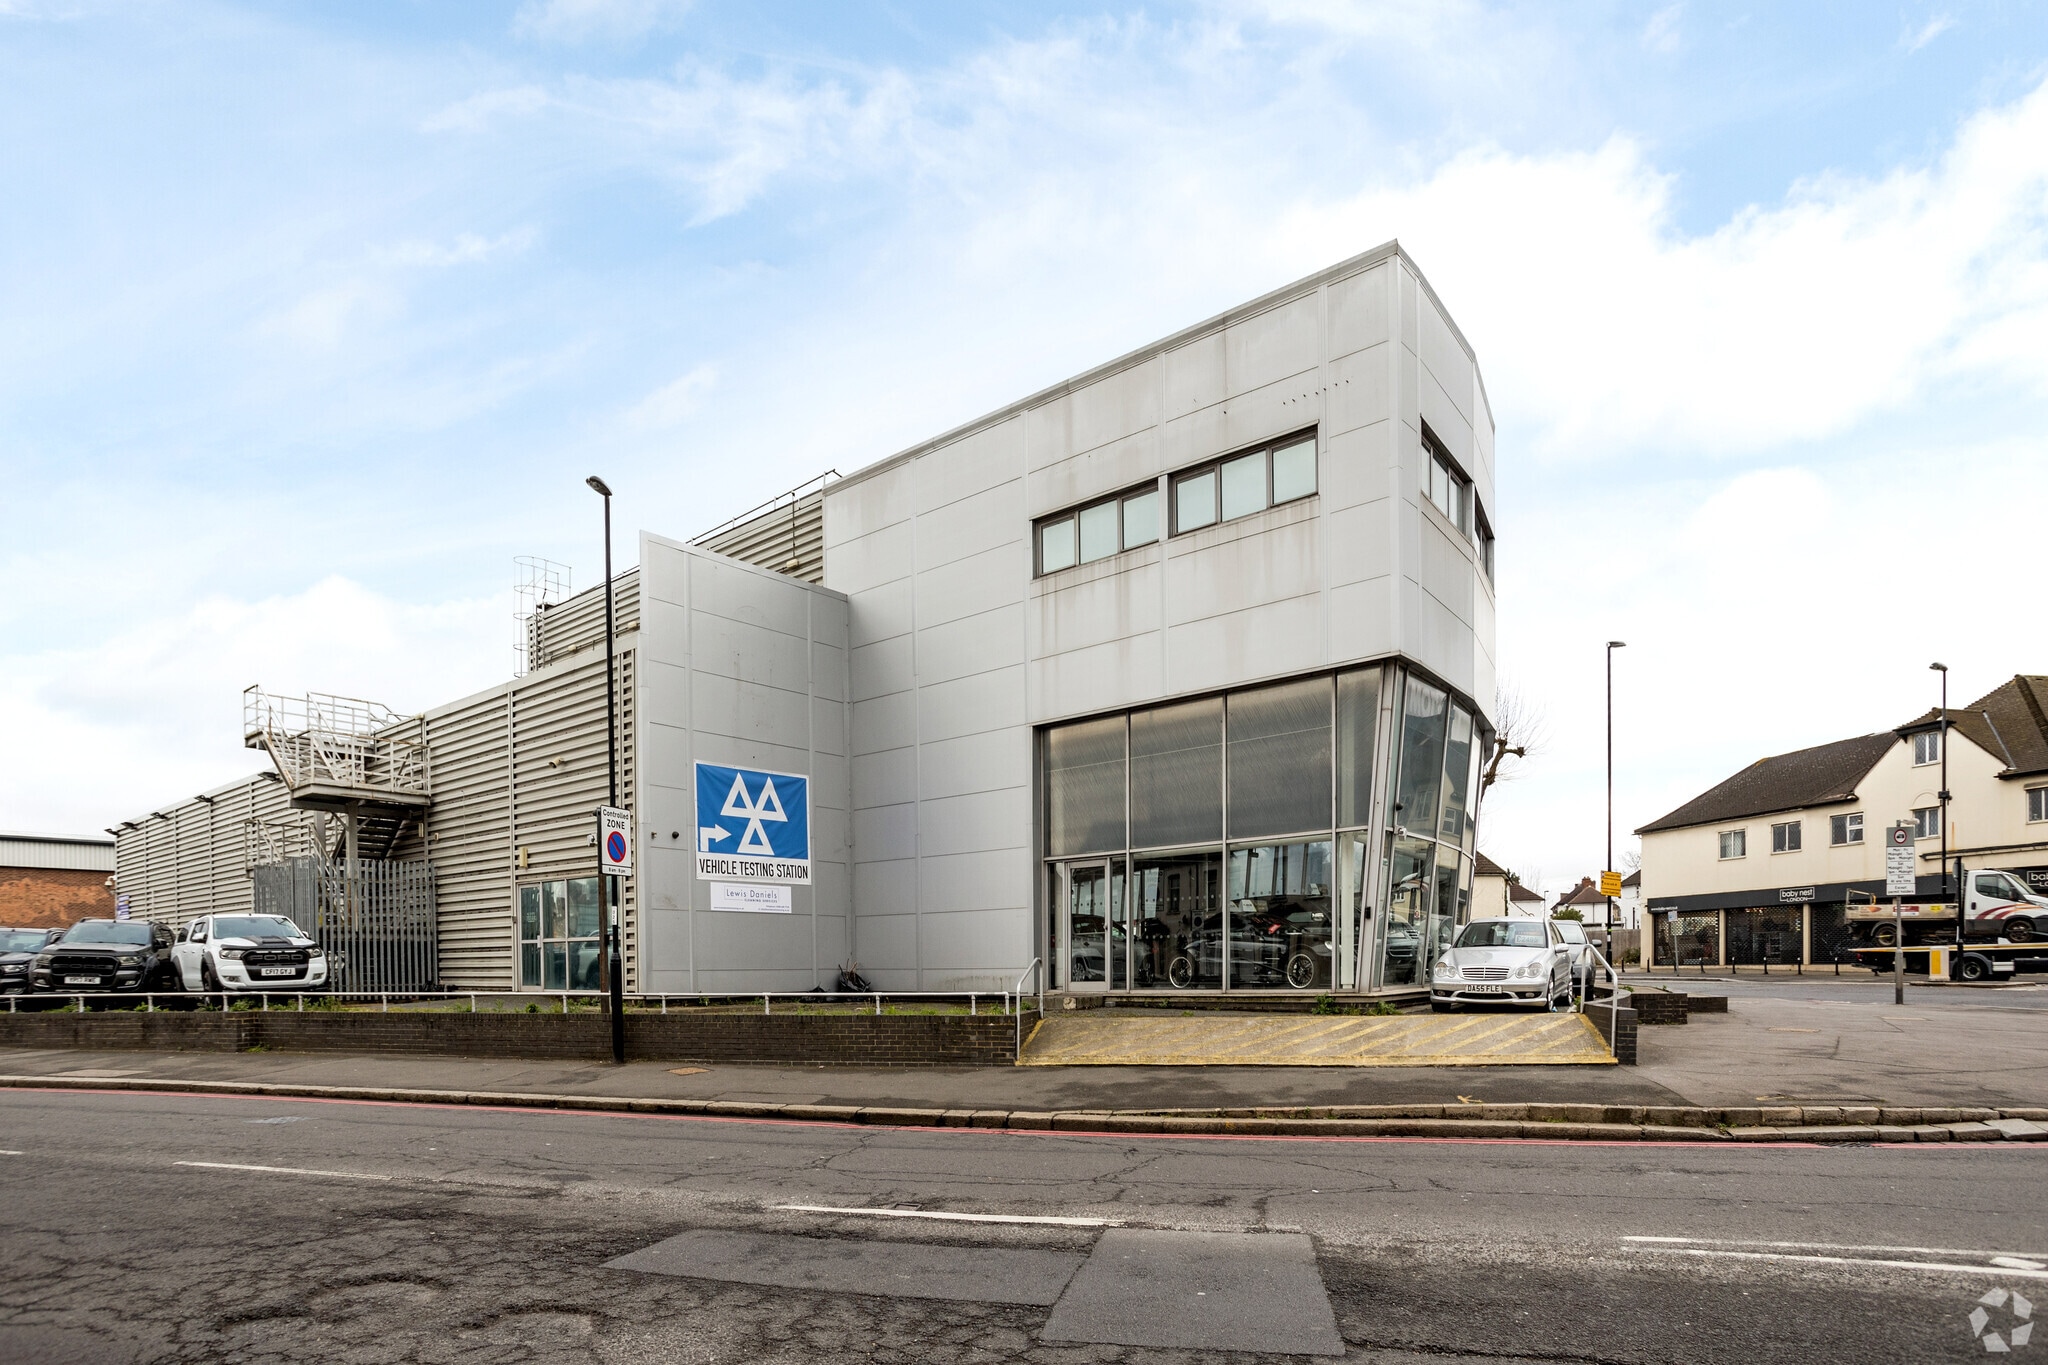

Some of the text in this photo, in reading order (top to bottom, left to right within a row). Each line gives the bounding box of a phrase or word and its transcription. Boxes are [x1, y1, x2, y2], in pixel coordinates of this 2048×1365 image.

[602, 808, 629, 820] Controlled
[606, 818, 625, 830] ZONE
[699, 858, 808, 879] VEHICLE TESTING STATION
[726, 888, 778, 899] Lewis Daniels
